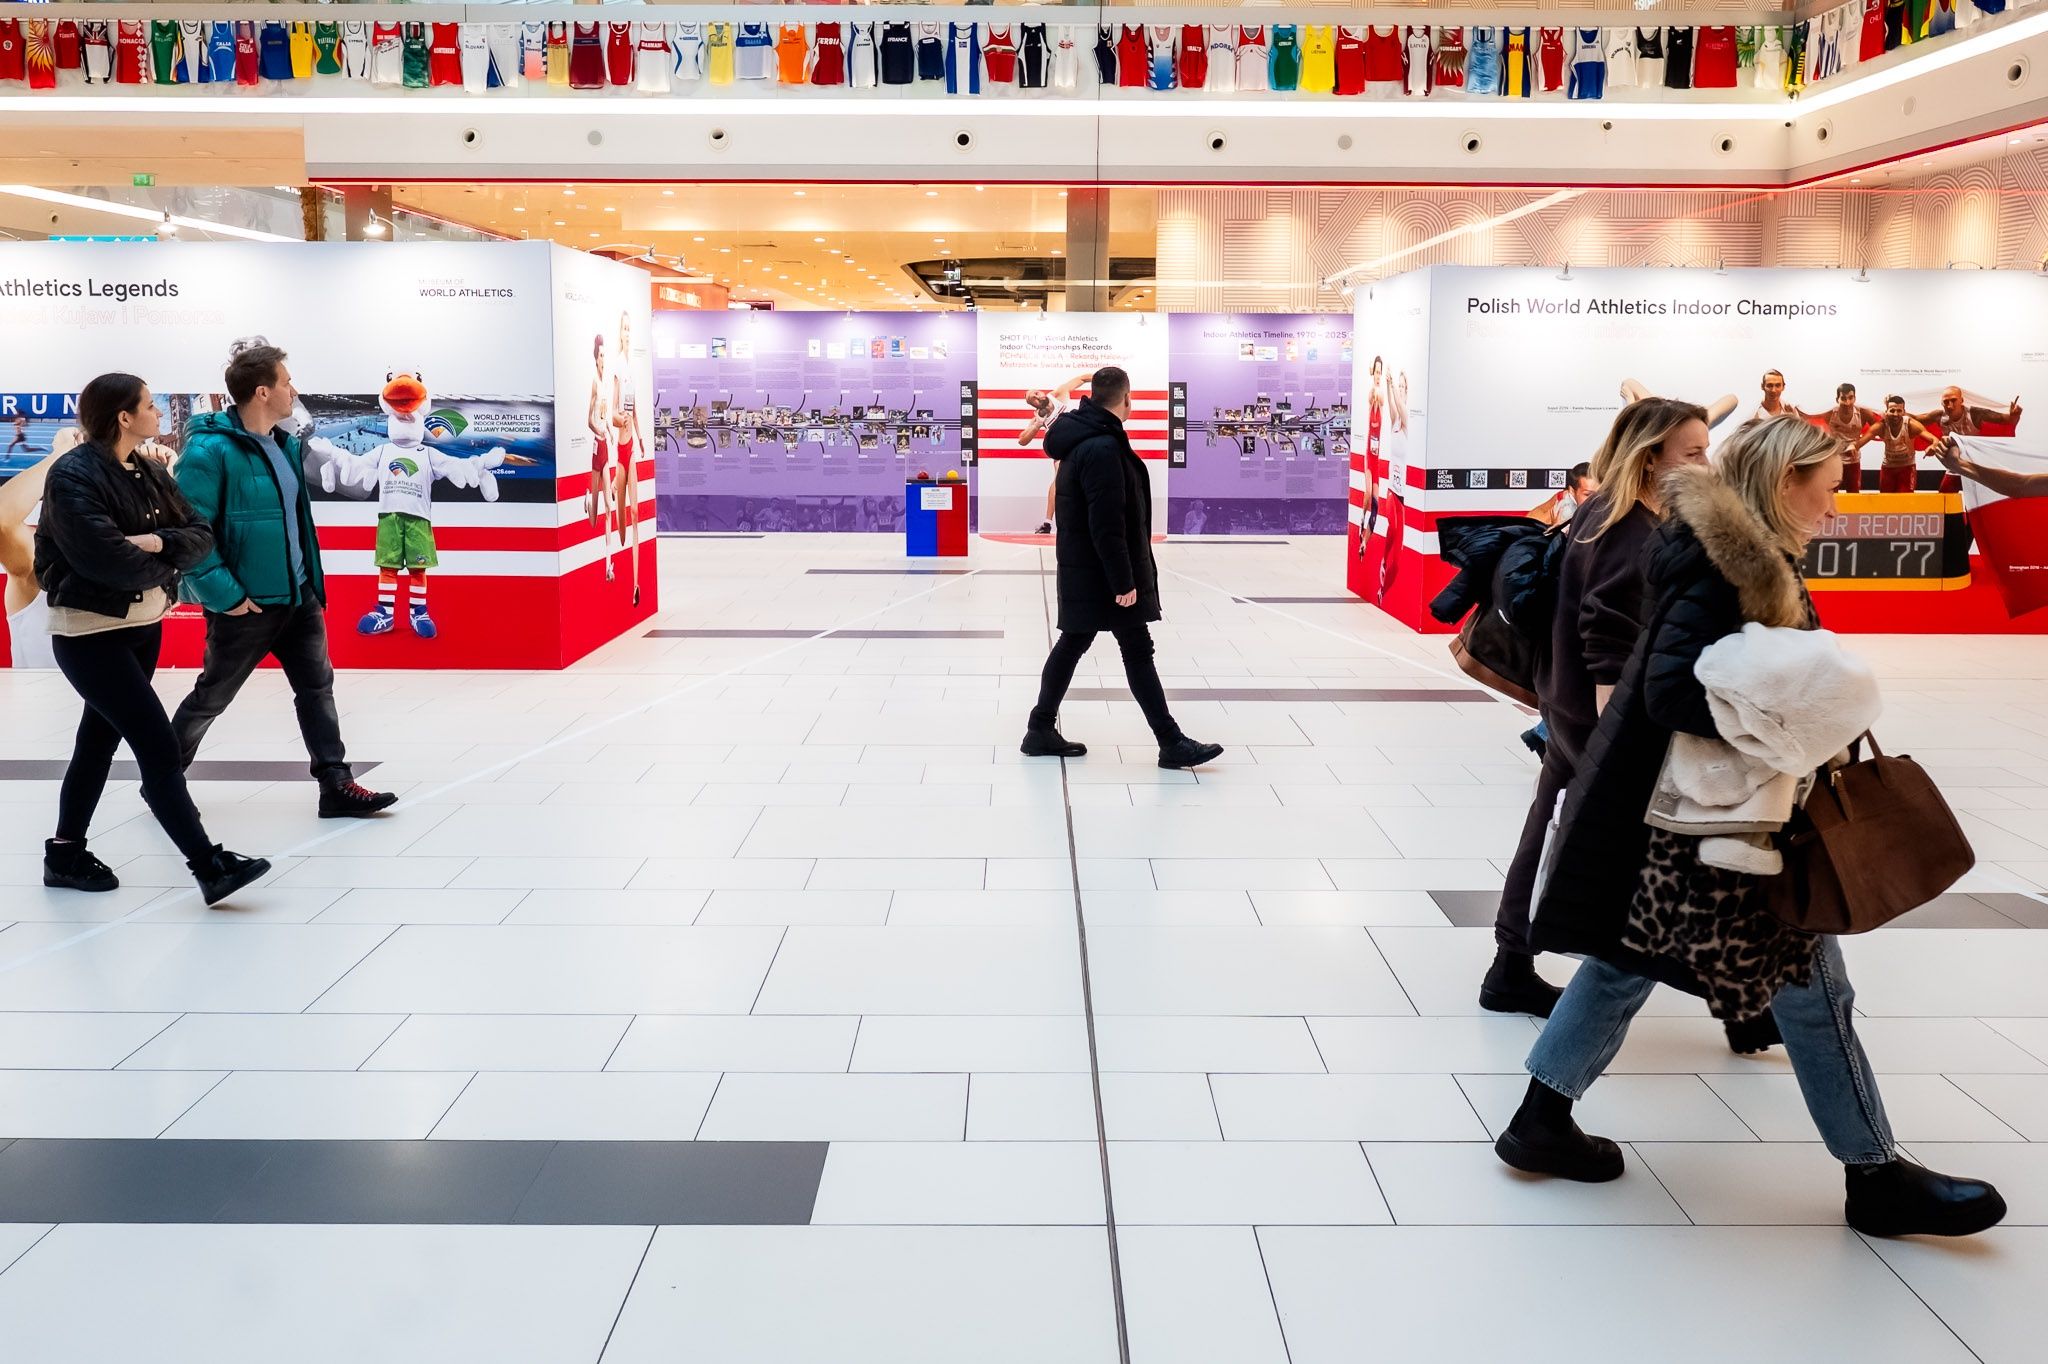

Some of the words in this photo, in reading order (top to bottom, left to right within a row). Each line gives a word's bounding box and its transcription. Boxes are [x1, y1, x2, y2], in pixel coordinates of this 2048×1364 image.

[89, 278, 179, 302] Legends
[419, 289, 456, 298] WORLD
[459, 289, 513, 298] ATHLETICS
[53, 305, 116, 330] Kujaw
[1467, 297, 1521, 315] Polish
[1527, 298, 1581, 315] World
[1586, 298, 1667, 315] Athletics
[1672, 298, 1731, 315] Indoor
[1737, 299, 1837, 320] Champions
[1026, 344, 1081, 352] Championships
[1858, 514, 1941, 537] RECORD
